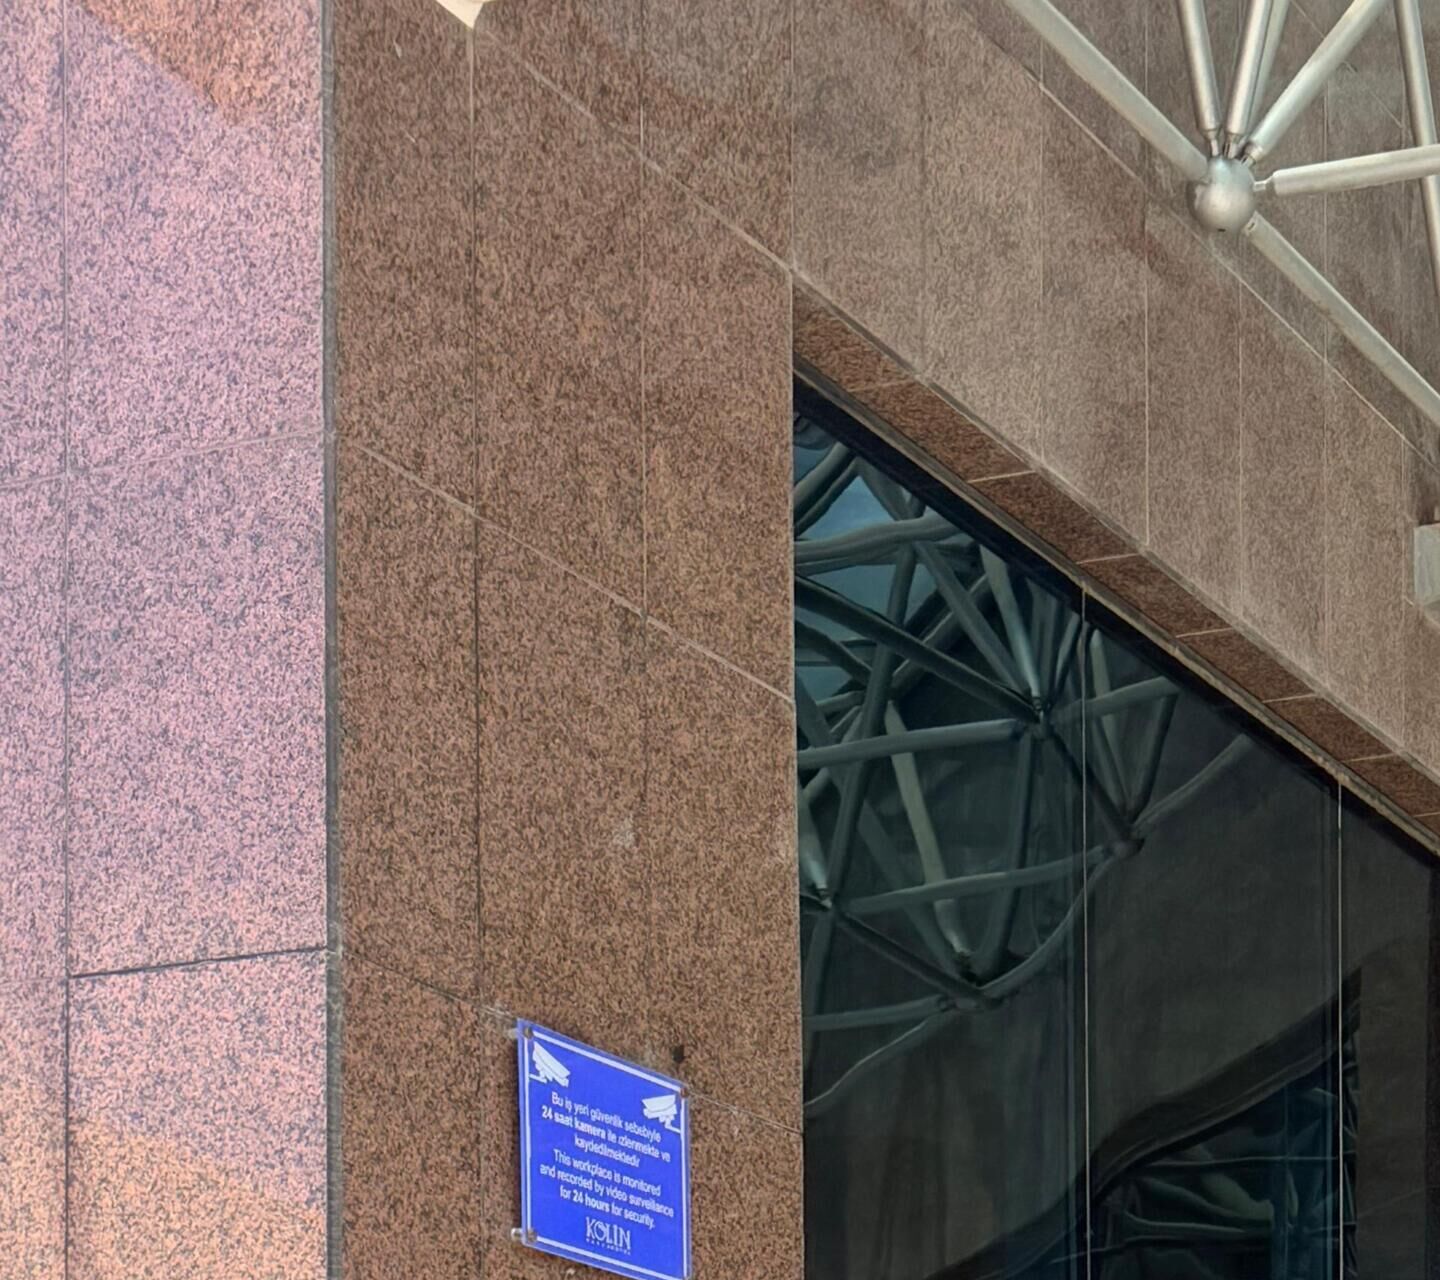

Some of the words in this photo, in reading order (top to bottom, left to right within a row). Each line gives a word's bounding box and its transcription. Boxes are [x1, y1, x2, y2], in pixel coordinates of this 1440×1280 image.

[541, 1105, 553, 1119] 24
[574, 1115, 606, 1139] kamera
[540, 1164, 556, 1179] and
[557, 1169, 593, 1191] recorded
[594, 1179, 605, 1197] by
[606, 1185, 628, 1202] video
[629, 1195, 674, 1217] surveillance
[554, 1149, 571, 1166] This
[572, 1156, 612, 1182] workplace
[613, 1166, 621, 1181] is
[622, 1172, 661, 1197] monitored
[560, 1184, 571, 1199] for
[573, 1190, 584, 1204] 24
[585, 1193, 610, 1212] hours
[611, 1200, 622, 1215] for
